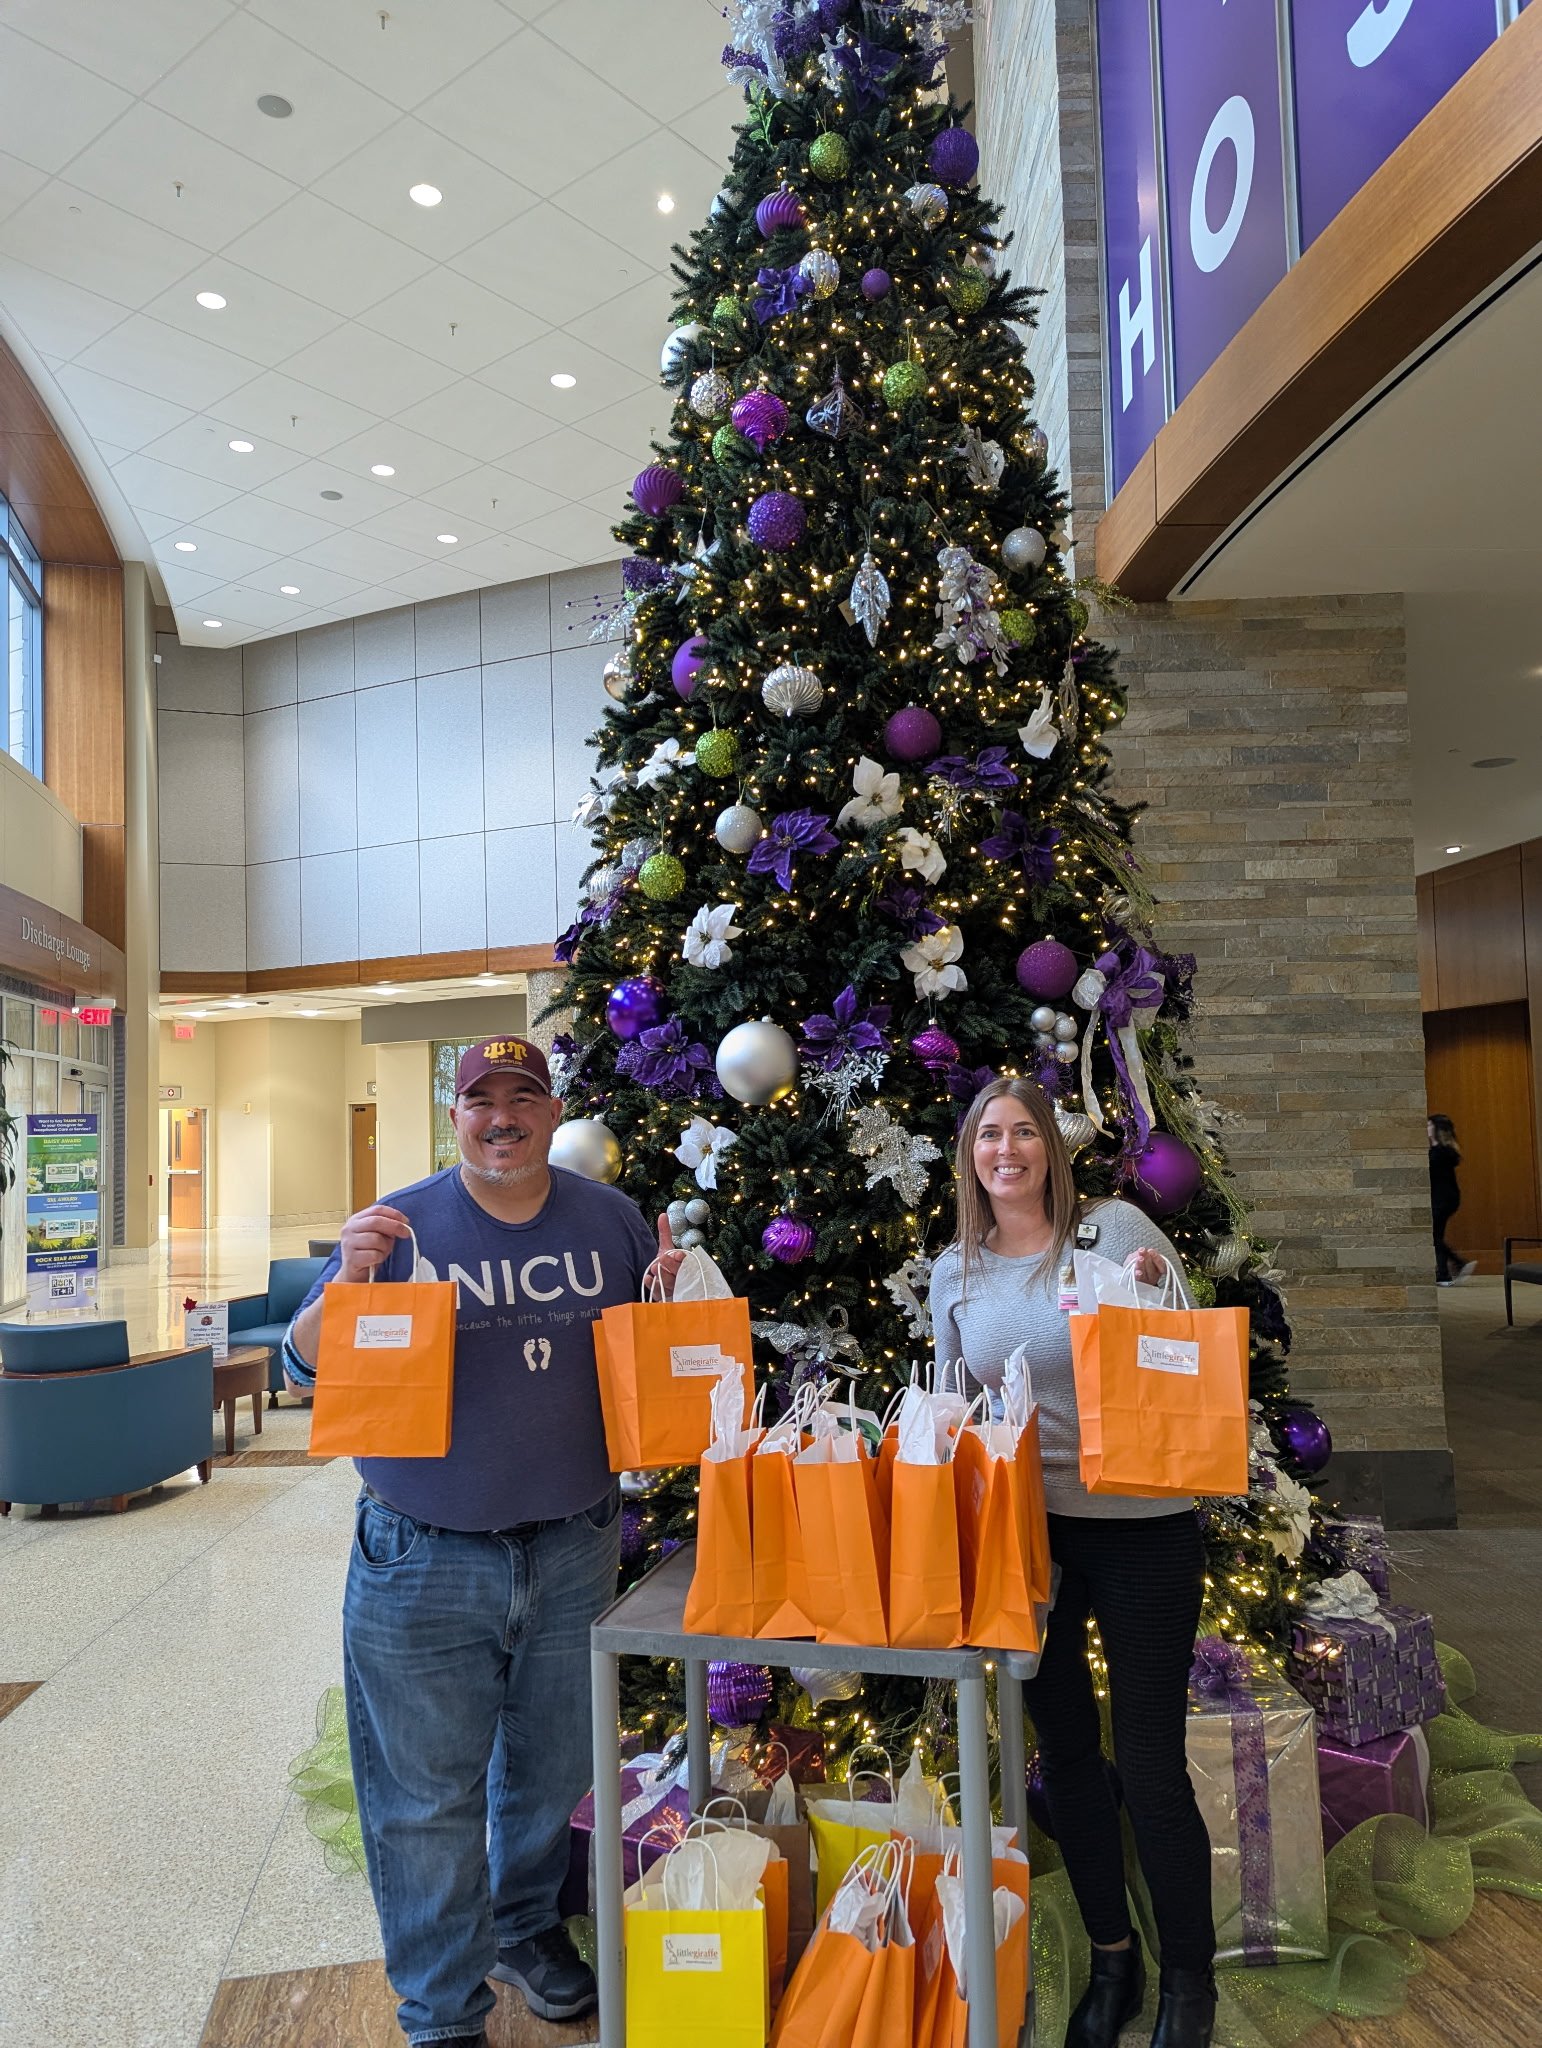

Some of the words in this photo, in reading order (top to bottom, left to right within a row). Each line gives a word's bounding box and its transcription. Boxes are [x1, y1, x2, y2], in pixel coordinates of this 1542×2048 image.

[21, 916, 65, 961] Discharge
[66, 937, 91, 973] Lounge
[83, 1008, 111, 1025] EXIT
[448, 1250, 604, 1310] NICU
[496, 1315, 513, 1328] the
[517, 1313, 543, 1326] little
[548, 1310, 575, 1326] things
[676, 1947, 718, 1960] littlegiraffe
